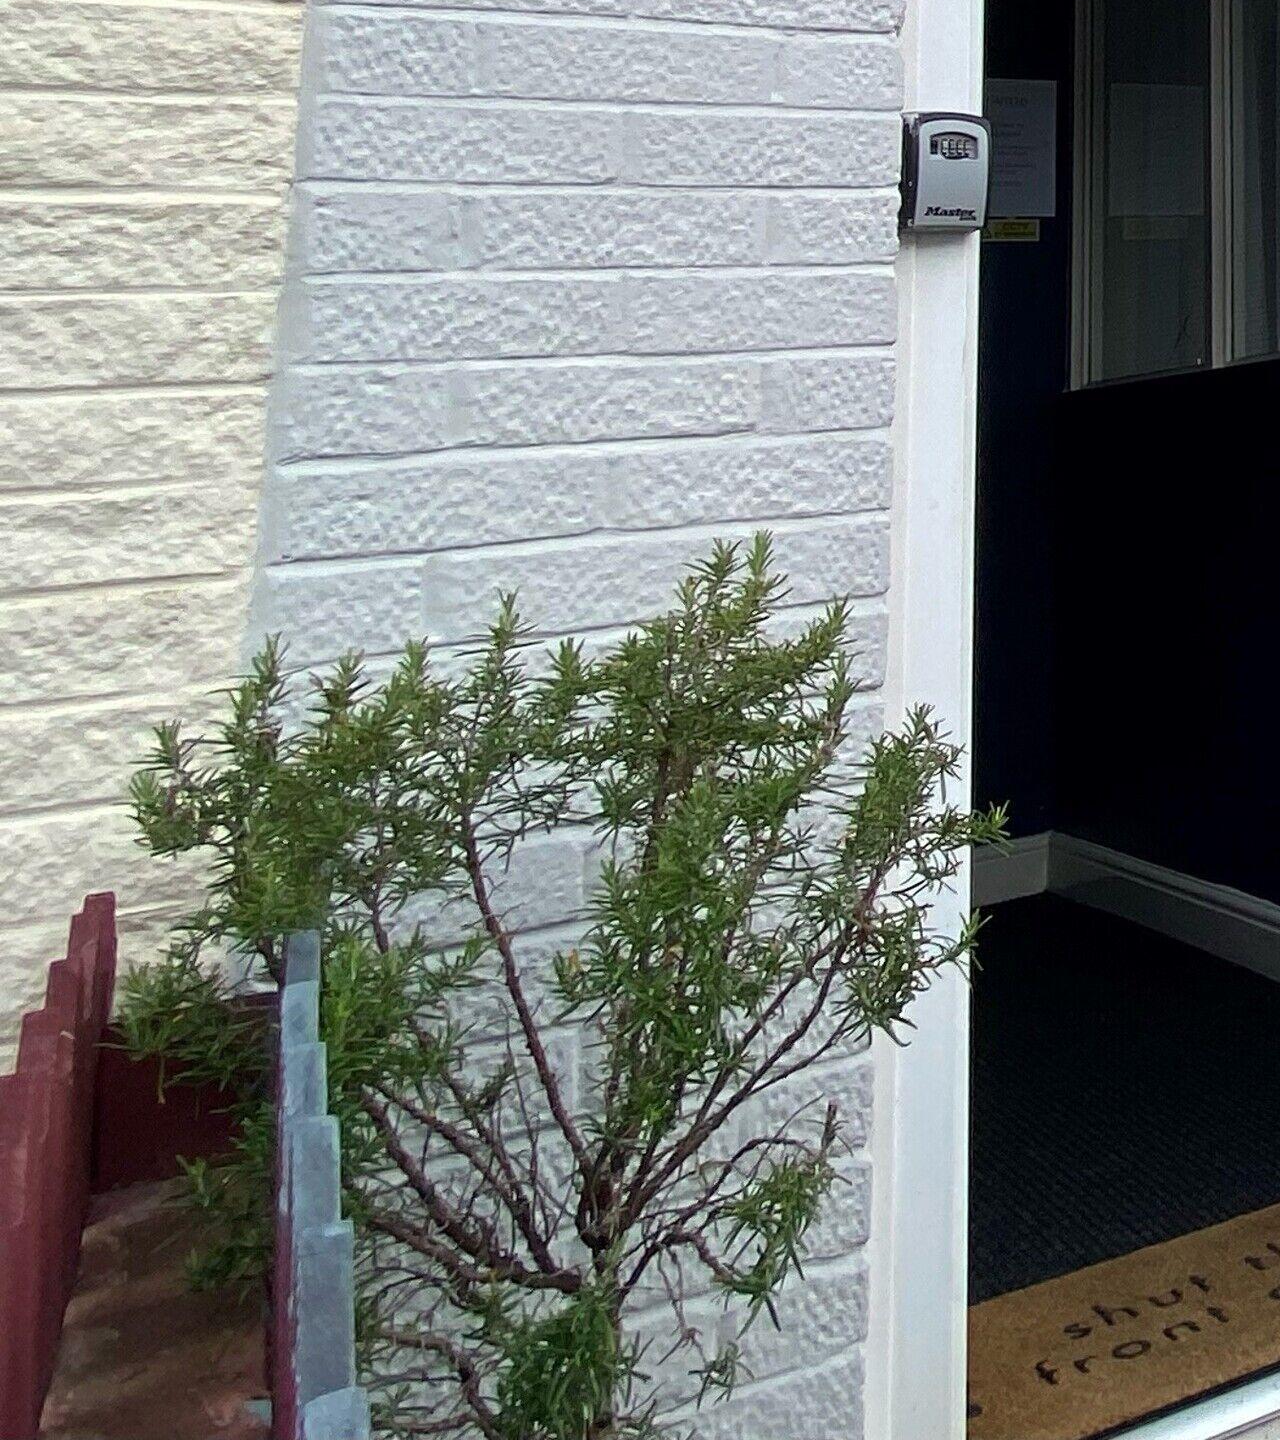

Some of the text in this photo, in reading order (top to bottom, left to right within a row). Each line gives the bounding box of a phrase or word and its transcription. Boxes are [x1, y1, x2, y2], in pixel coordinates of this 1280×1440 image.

[924, 206, 975, 217] Master
[1063, 1274, 1211, 1340] shut
[1035, 1305, 1230, 1386] front
